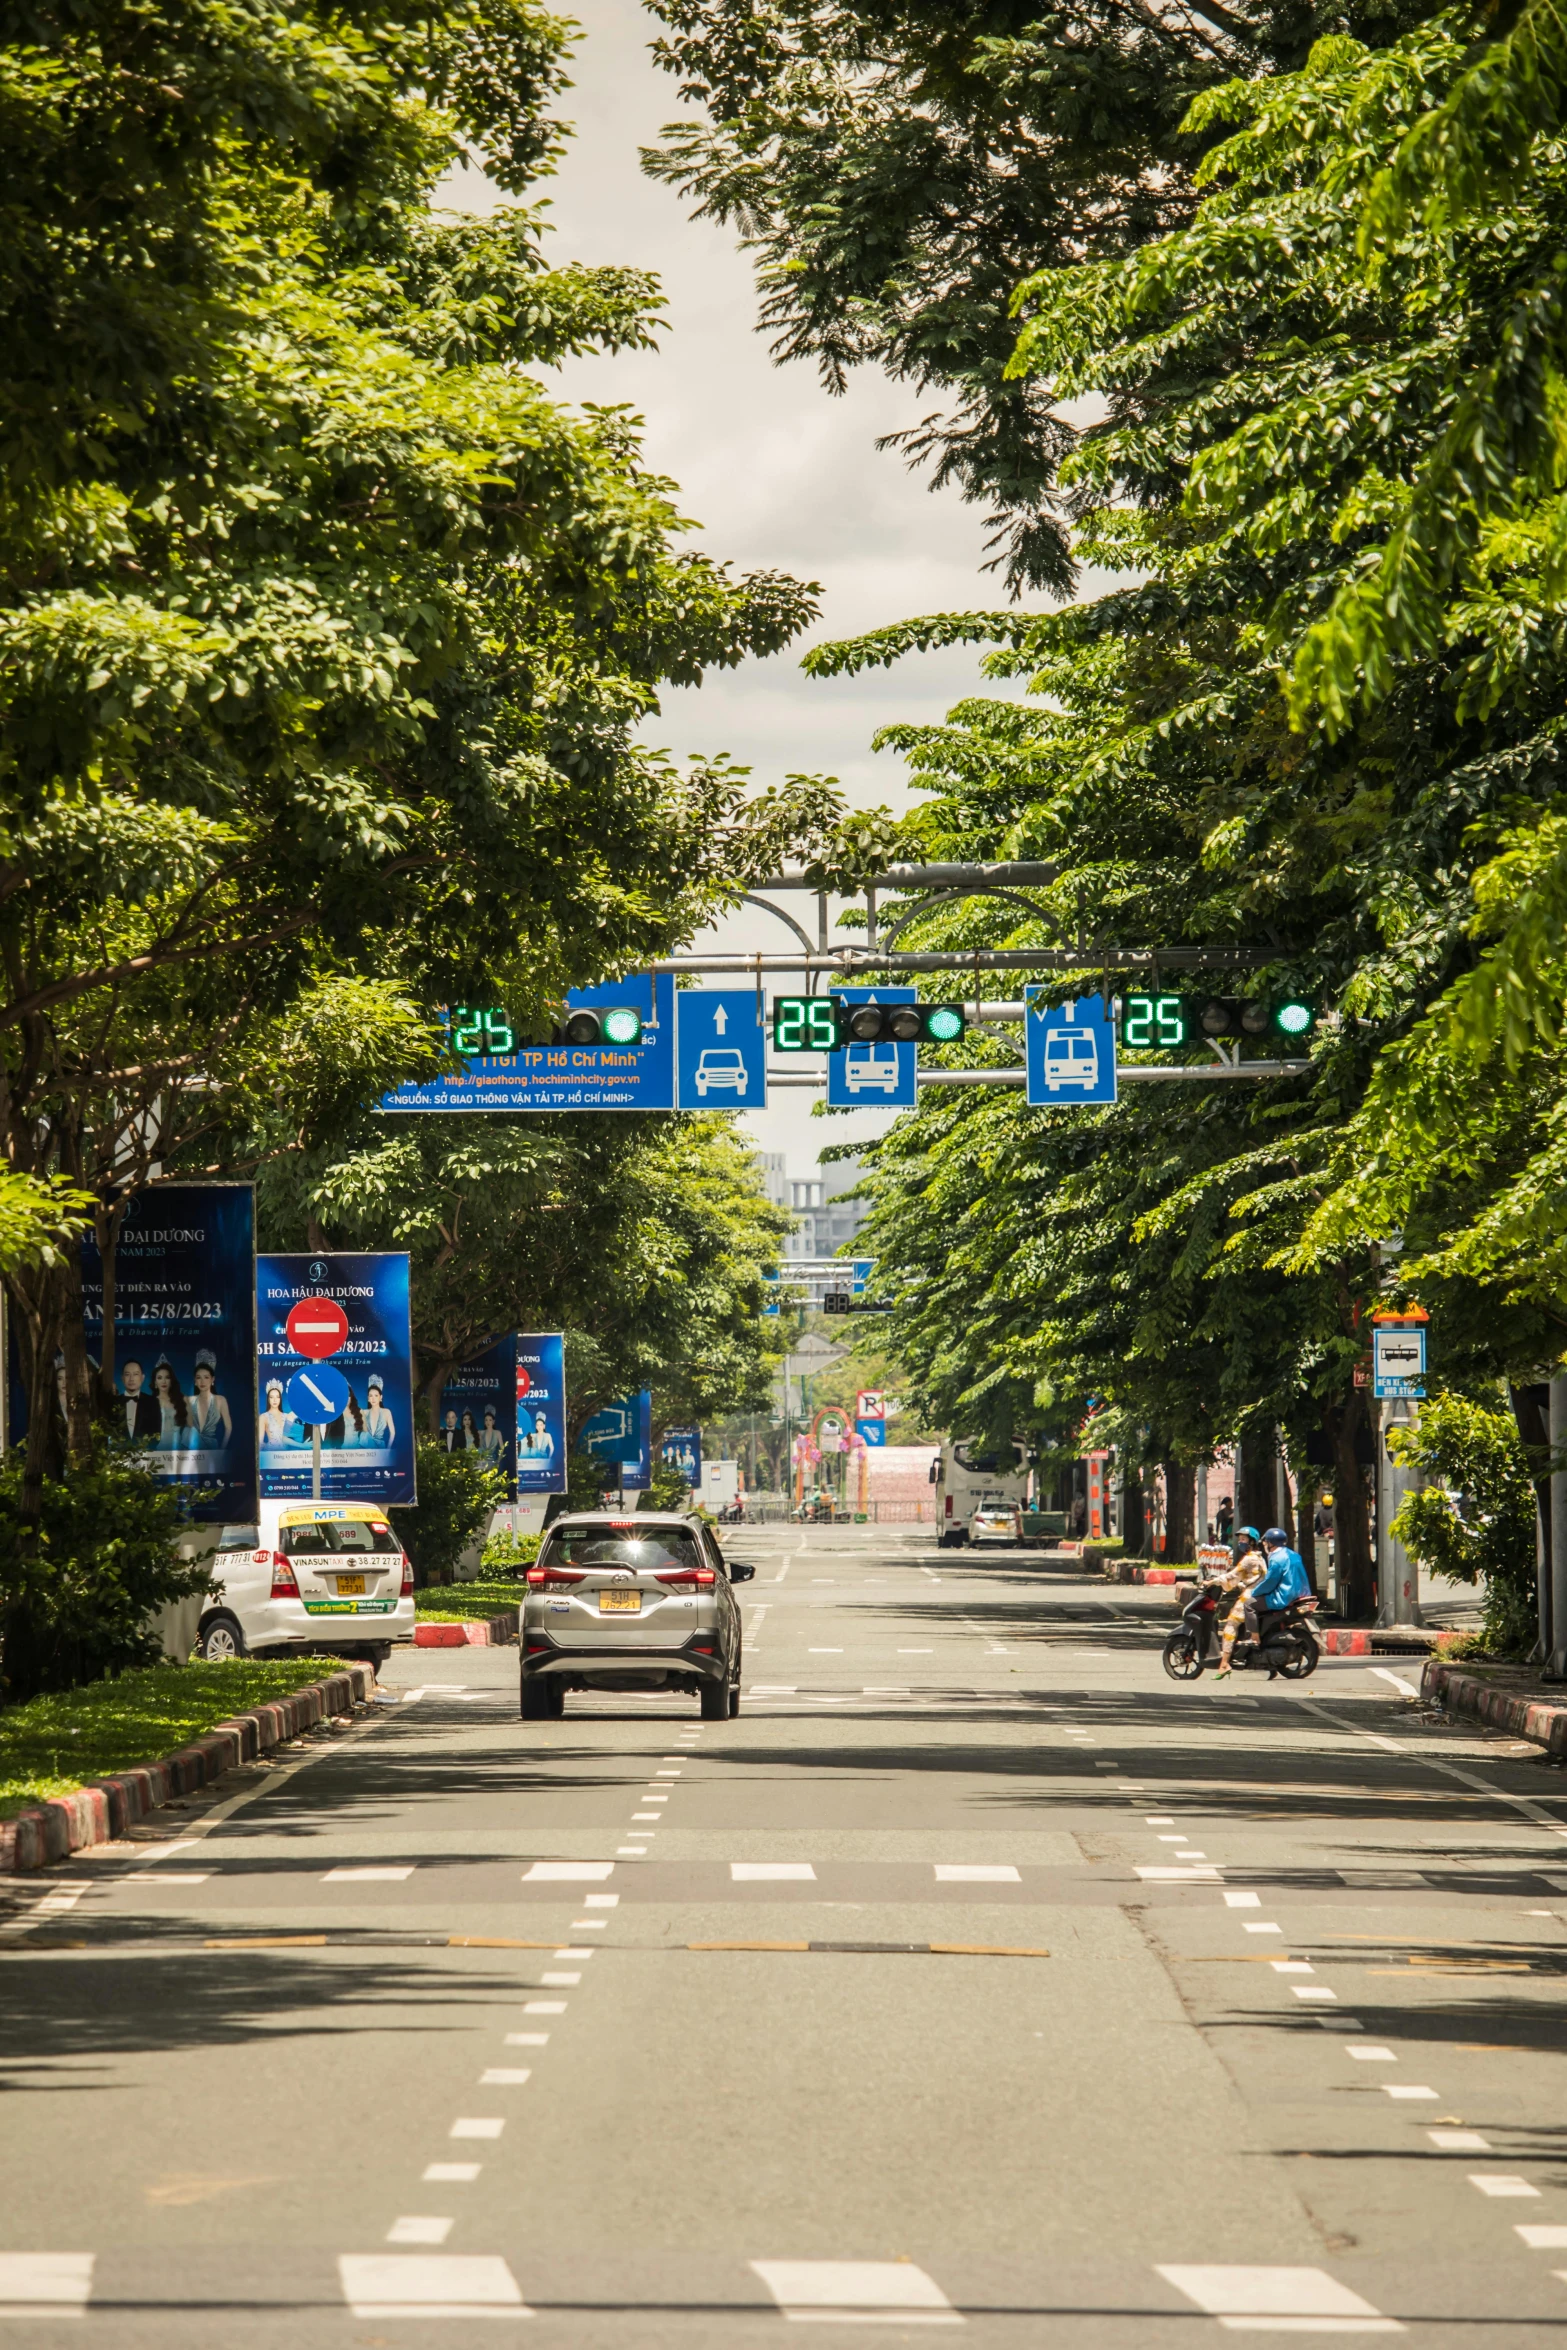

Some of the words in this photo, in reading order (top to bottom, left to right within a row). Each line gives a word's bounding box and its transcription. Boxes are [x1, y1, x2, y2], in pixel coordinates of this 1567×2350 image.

[782, 1001, 835, 1047] 25
[1127, 998, 1182, 1045] 25
[523, 1053, 543, 1067] TP
[547, 1051, 568, 1067] Hồ
[572, 1051, 596, 1067] Chí
[450, 1094, 473, 1104] GIAO
[475, 1092, 509, 1104] THÔNG
[511, 1092, 532, 1105] VẬN
[534, 1090, 550, 1103] TẢI
[584, 1092, 600, 1103] CHÍ
[124, 1230, 149, 1244] ĐẠI
[153, 1228, 205, 1243] DƯƠNG
[120, 1248, 143, 1256] NAM
[146, 1248, 166, 1256] 2023
[154, 1284, 168, 1292] RA
[170, 1281, 191, 1292] VÀO
[267, 1288, 290, 1298] HOA
[292, 1285, 314, 1299] HẬU
[315, 1287, 334, 1298] ĐẠI
[337, 1285, 374, 1297] DƯƠNG
[140, 1302, 222, 1319] 25/8/2023
[456, 1378, 500, 1388] 25/8/2023
[314, 1510, 346, 1519] MPE
[345, 1576, 356, 1584] 51F
[611, 1591, 630, 1599] 51H
[605, 1600, 637, 1609] 762.21
